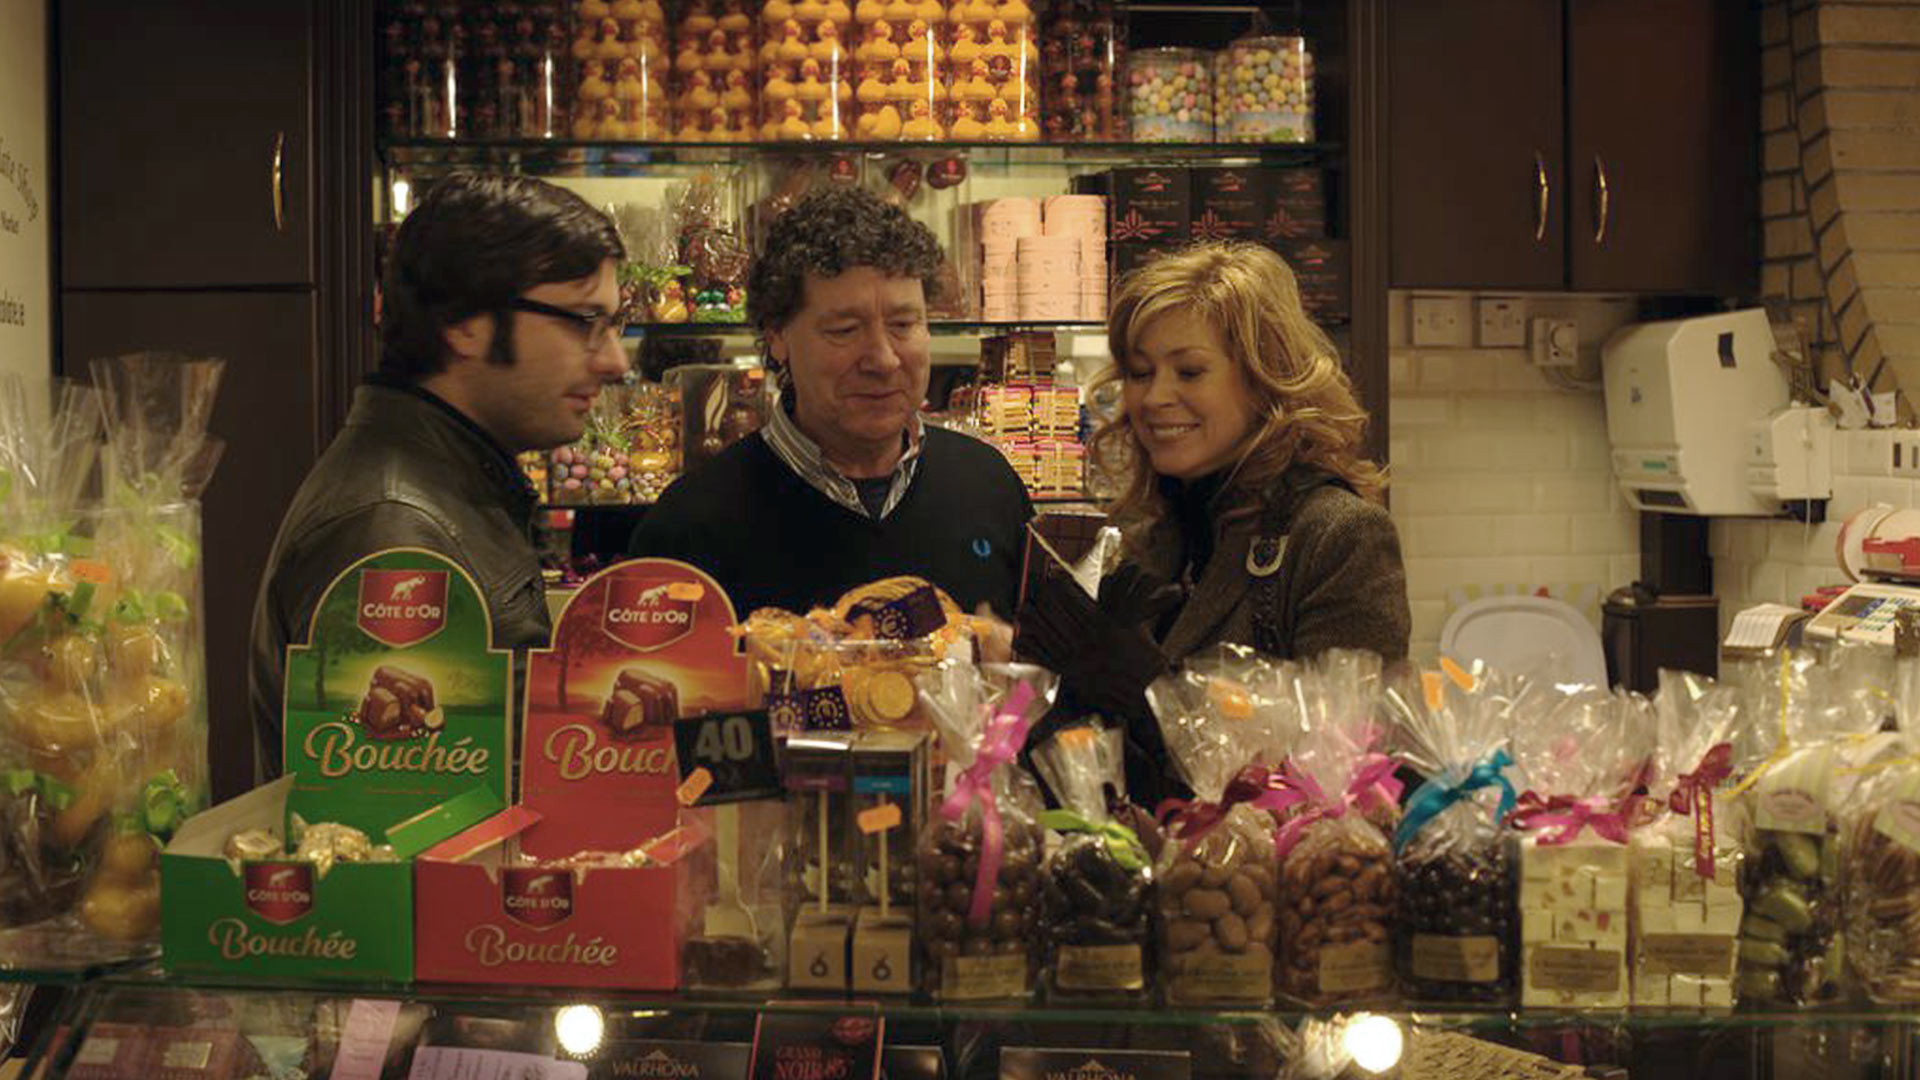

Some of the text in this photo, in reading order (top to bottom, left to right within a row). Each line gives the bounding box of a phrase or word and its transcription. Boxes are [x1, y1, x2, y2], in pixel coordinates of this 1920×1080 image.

[363, 602, 402, 619] CÔTE
[608, 607, 649, 624] CÔTE
[695, 716, 753, 762] 40
[303, 721, 489, 778] Bouchée
[248, 888, 279, 901] CÔTE
[506, 895, 538, 909] CÔTE
[208, 917, 358, 960] Bouchée
[464, 923, 619, 967] Bouchée
[612, 1059, 700, 1079] VALRHONA
